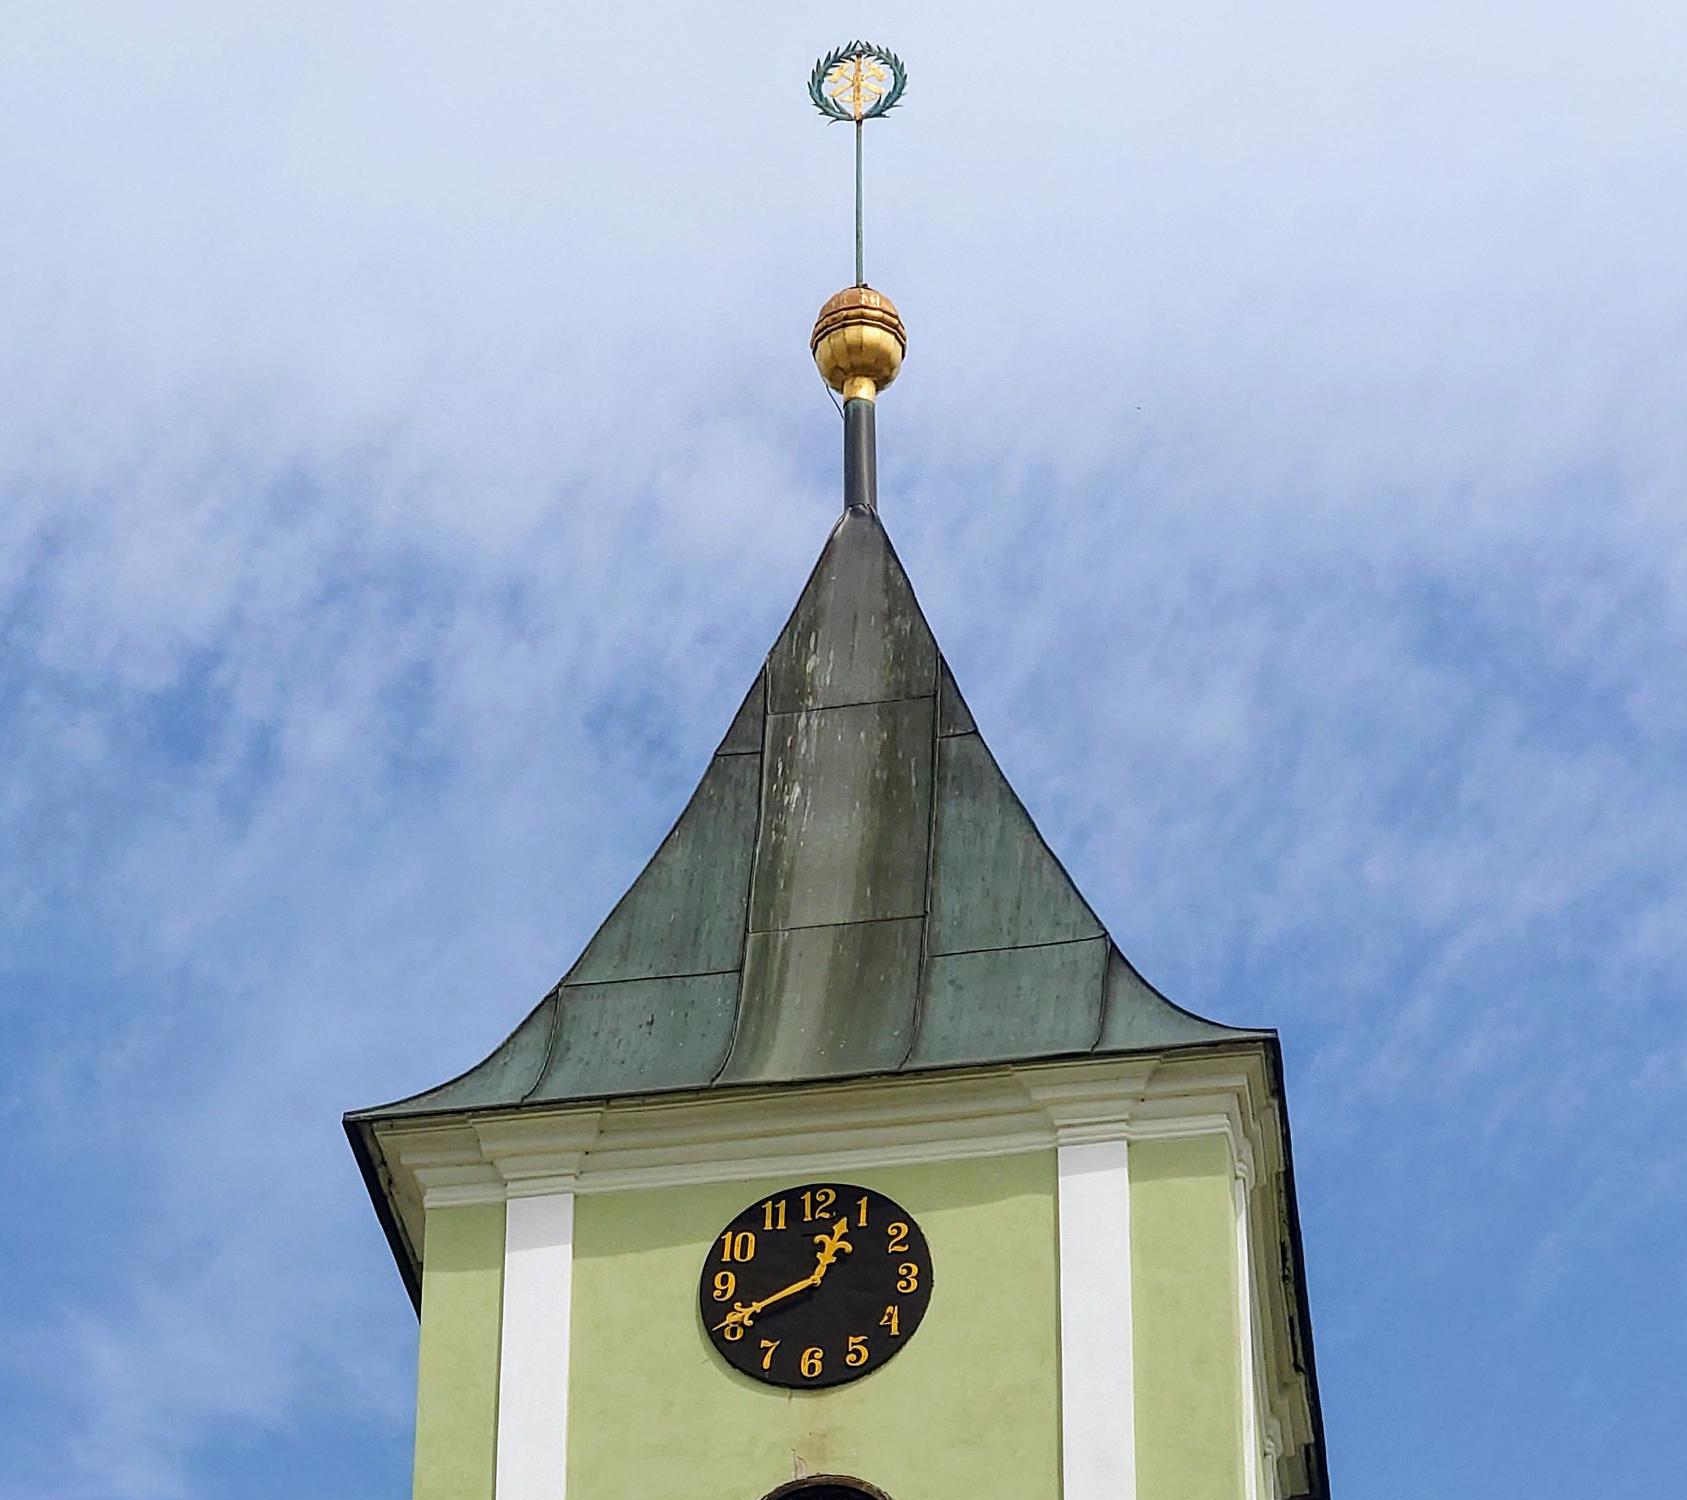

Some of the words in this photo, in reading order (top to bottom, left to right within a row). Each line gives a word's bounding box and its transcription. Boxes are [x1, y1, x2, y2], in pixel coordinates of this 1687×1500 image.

[762, 1201, 786, 1230] 11
[801, 1189, 836, 1222] 12
[857, 1196, 867, 1226] 1
[721, 1232, 755, 1262] 10
[888, 1223, 909, 1253] 2
[713, 1271, 735, 1301] 9
[897, 1263, 918, 1293] 3
[880, 1305, 899, 1336] 4
[761, 1340, 780, 1369] 7
[801, 1348, 823, 1377] 6
[846, 1336, 869, 1366] 5
